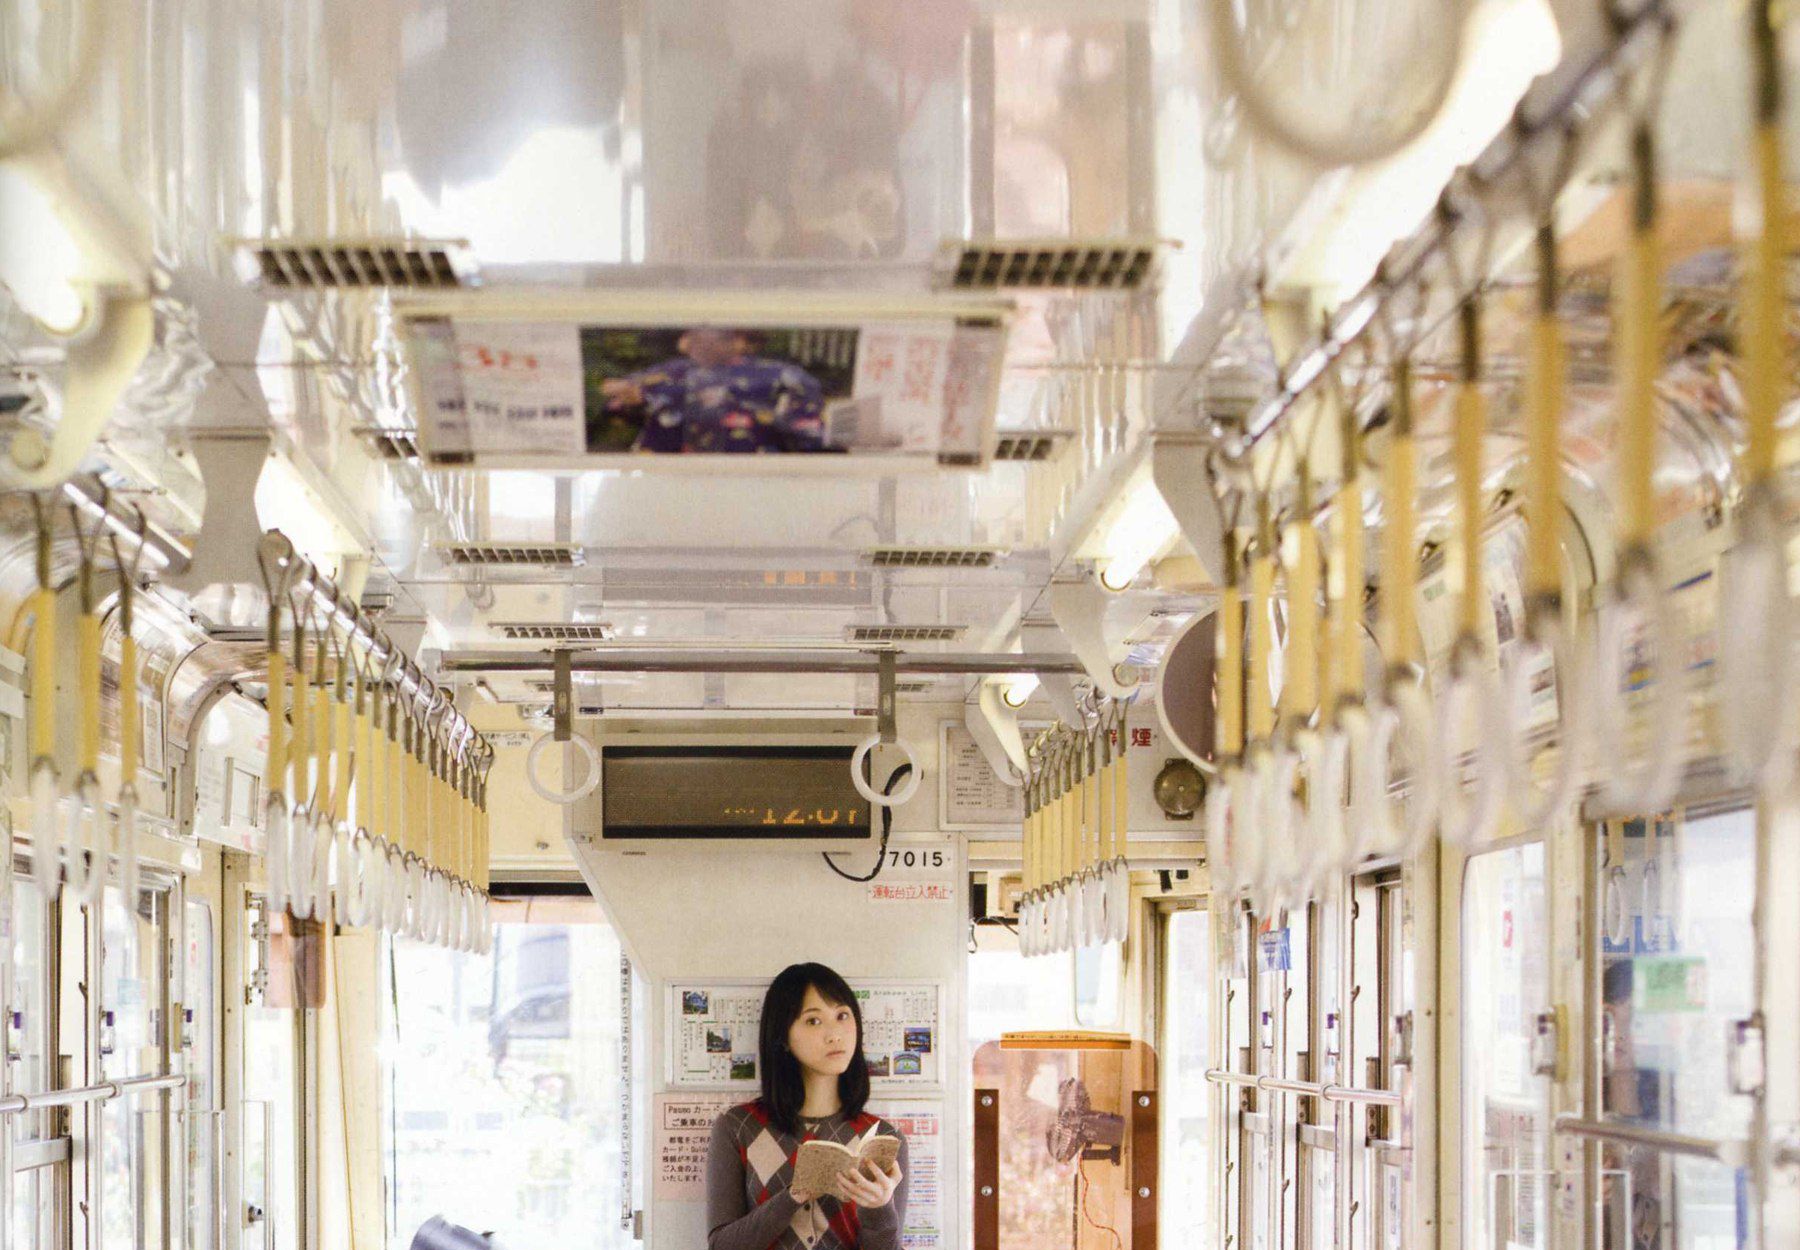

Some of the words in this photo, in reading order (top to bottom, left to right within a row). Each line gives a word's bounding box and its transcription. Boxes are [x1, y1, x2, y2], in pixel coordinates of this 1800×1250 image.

[888, 851, 943, 867] 7015
[872, 885, 949, 899] 運転台立入禁止
